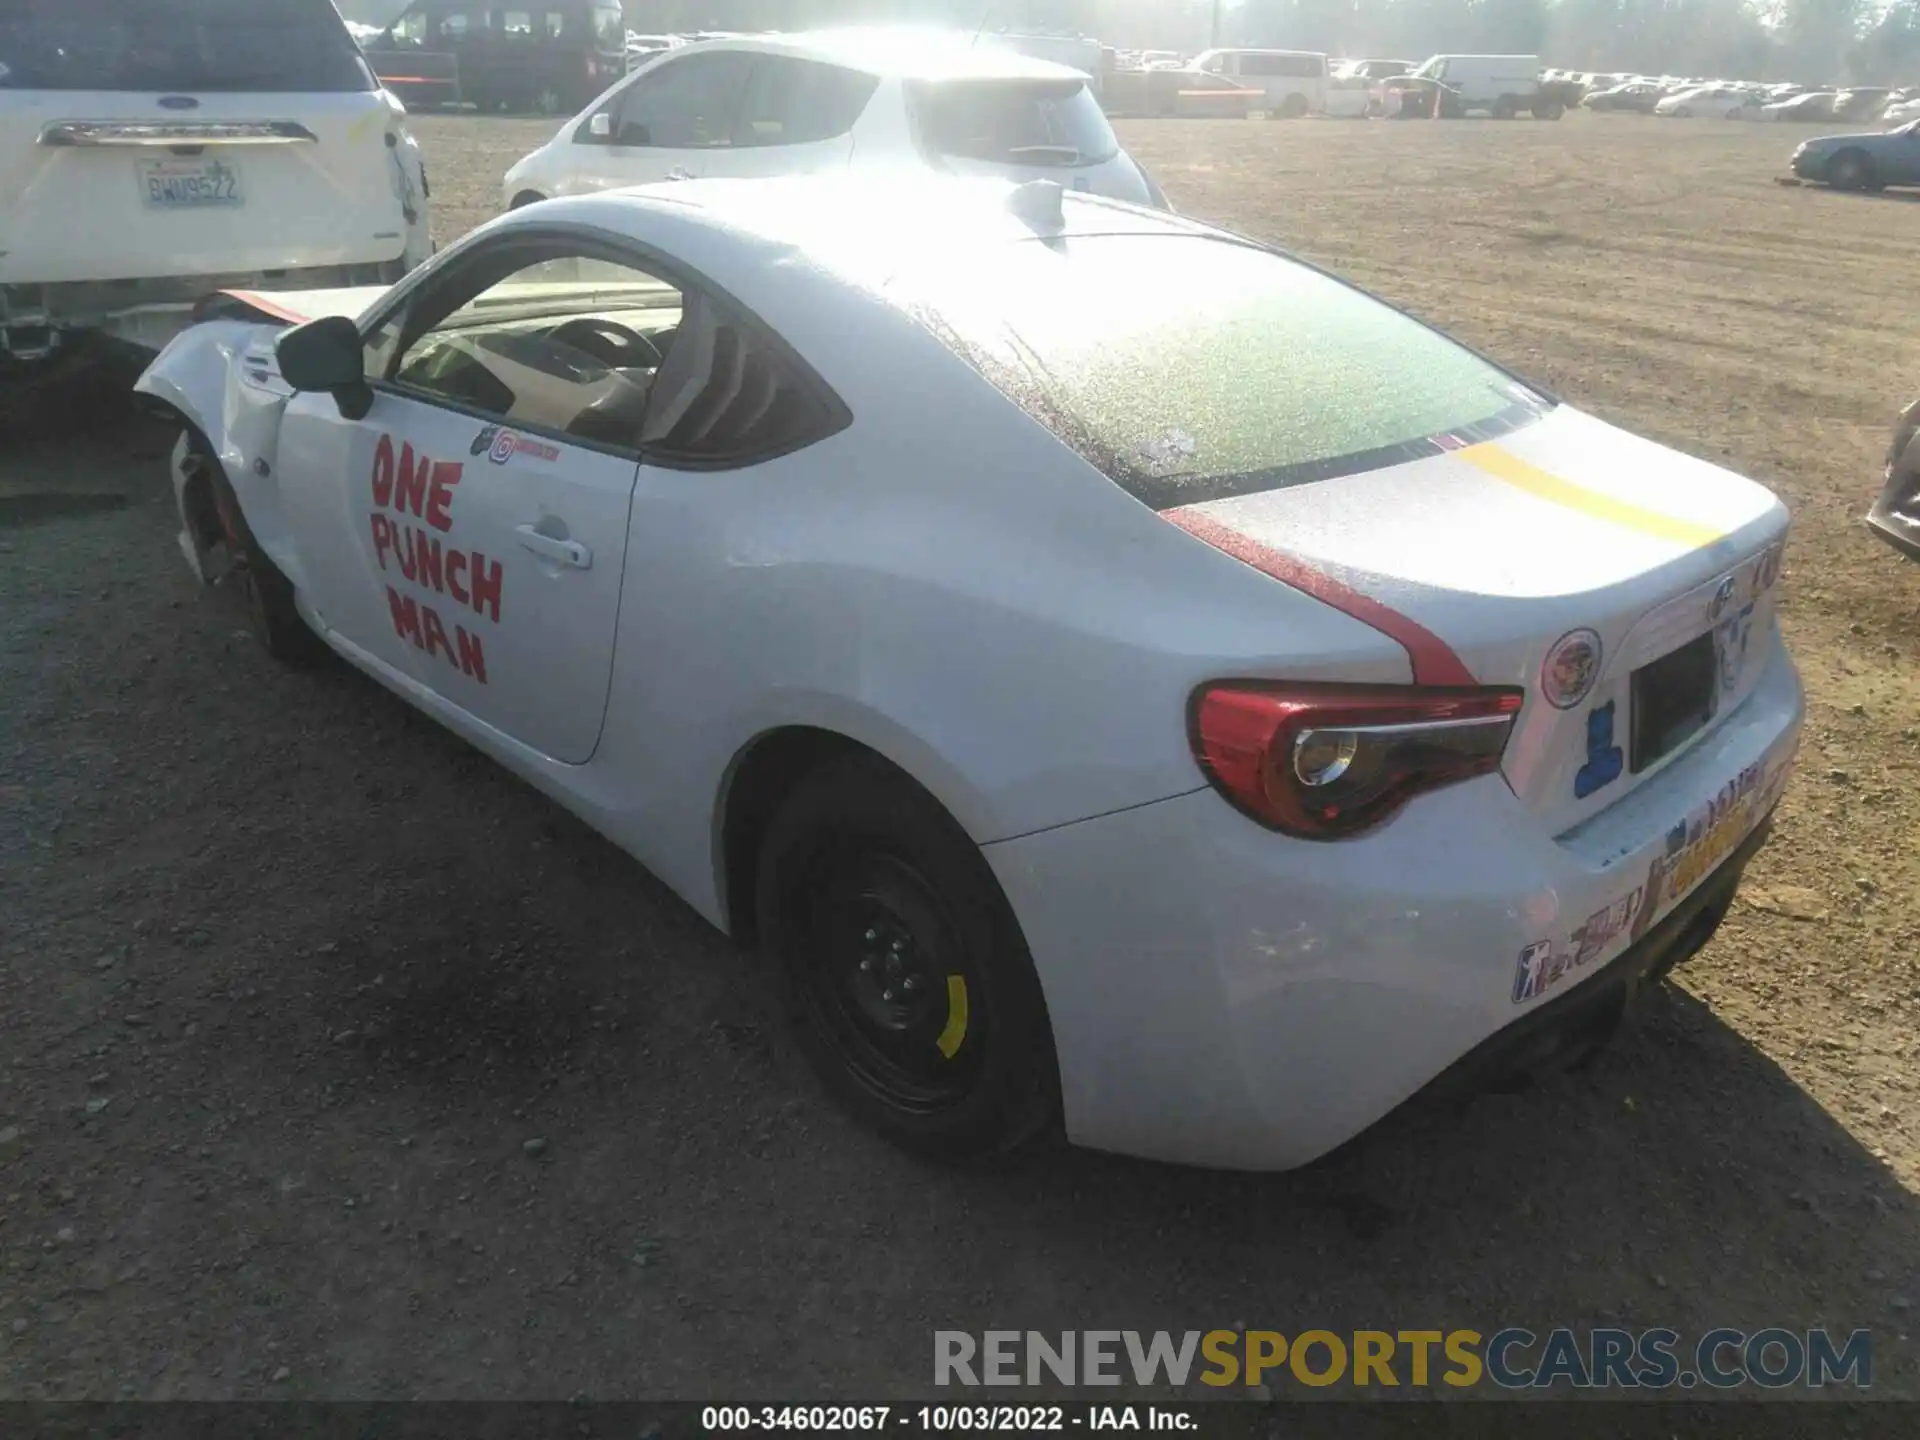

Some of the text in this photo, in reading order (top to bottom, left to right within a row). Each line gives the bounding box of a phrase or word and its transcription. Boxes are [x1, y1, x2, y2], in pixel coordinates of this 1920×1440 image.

[371, 433, 464, 533] ONE
[369, 513, 504, 624] PUNCH
[386, 583, 488, 685] MAN
